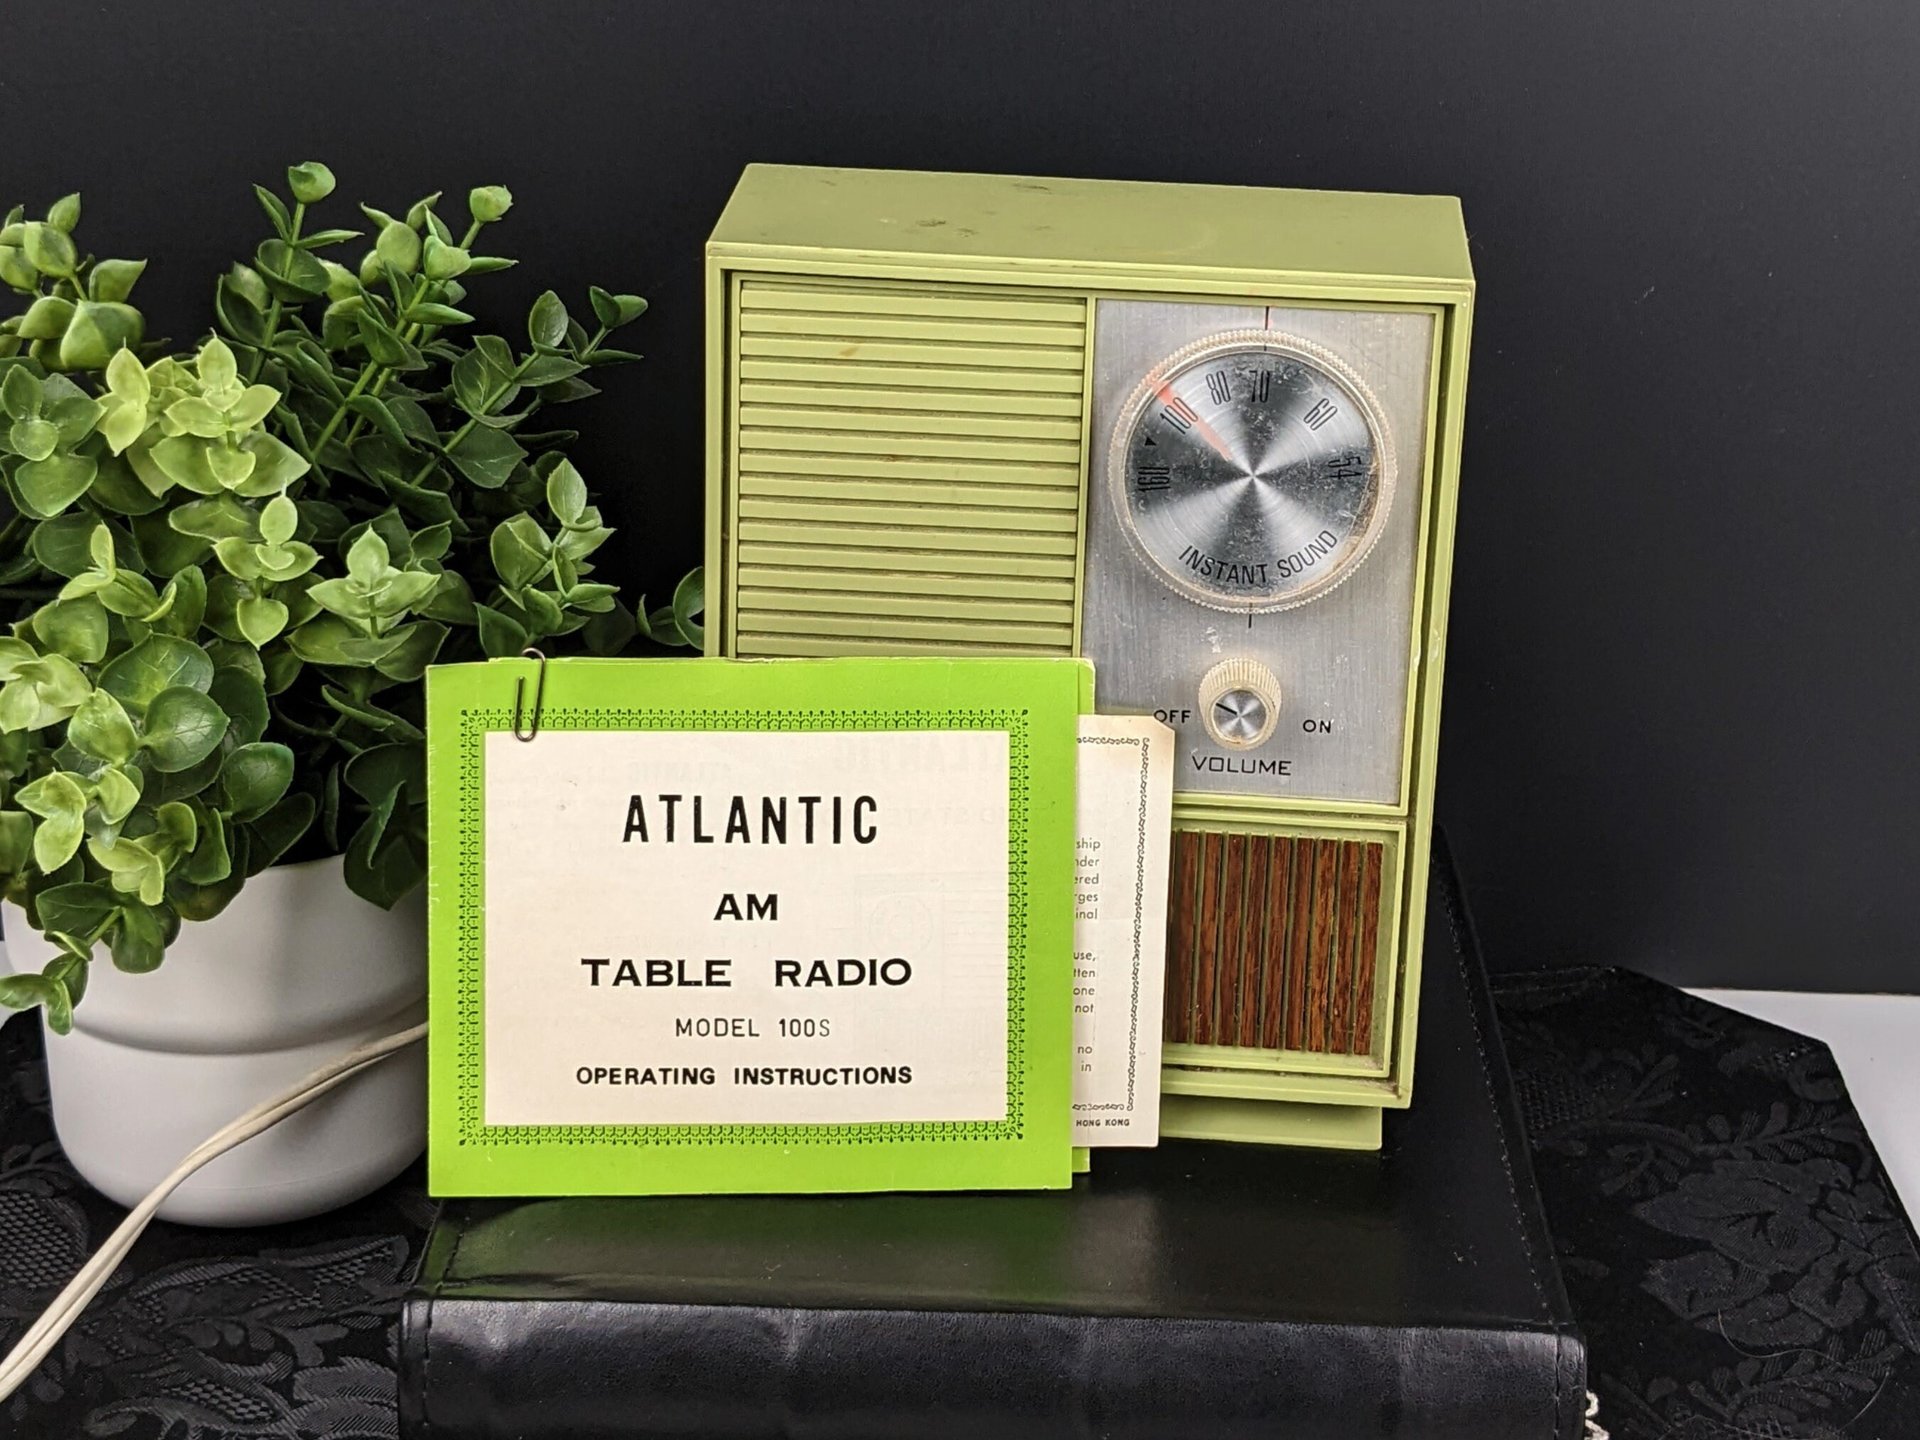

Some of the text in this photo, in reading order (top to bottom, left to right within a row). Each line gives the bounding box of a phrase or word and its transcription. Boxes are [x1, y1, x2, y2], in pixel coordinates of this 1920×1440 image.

[1206, 370, 1231, 405] 80
[1249, 370, 1271, 403] 70
[1160, 397, 1198, 434] 100
[1303, 398, 1338, 431] 60
[1328, 456, 1362, 480] 54
[1137, 466, 1171, 492] 160
[1178, 530, 1338, 584] INSTANT SOUND
[1154, 709, 1191, 723] OFF
[1302, 719, 1332, 733] ON
[1192, 756, 1292, 776] VOLUME
[622, 794, 879, 845] ATLANTIC
[713, 893, 779, 921] AM
[1074, 893, 1098, 905] ges
[581, 958, 913, 987] TABLE RADIO
[1073, 987, 1095, 996] one
[1075, 1003, 1094, 1013] not
[676, 1018, 831, 1038] MODEL 100S
[1077, 1046, 1093, 1055] no
[576, 1066, 913, 1086] OPERATING INSTRUCTIONS
[1081, 1061, 1092, 1072] in
[1076, 1118, 1130, 1127] HONG KONG
